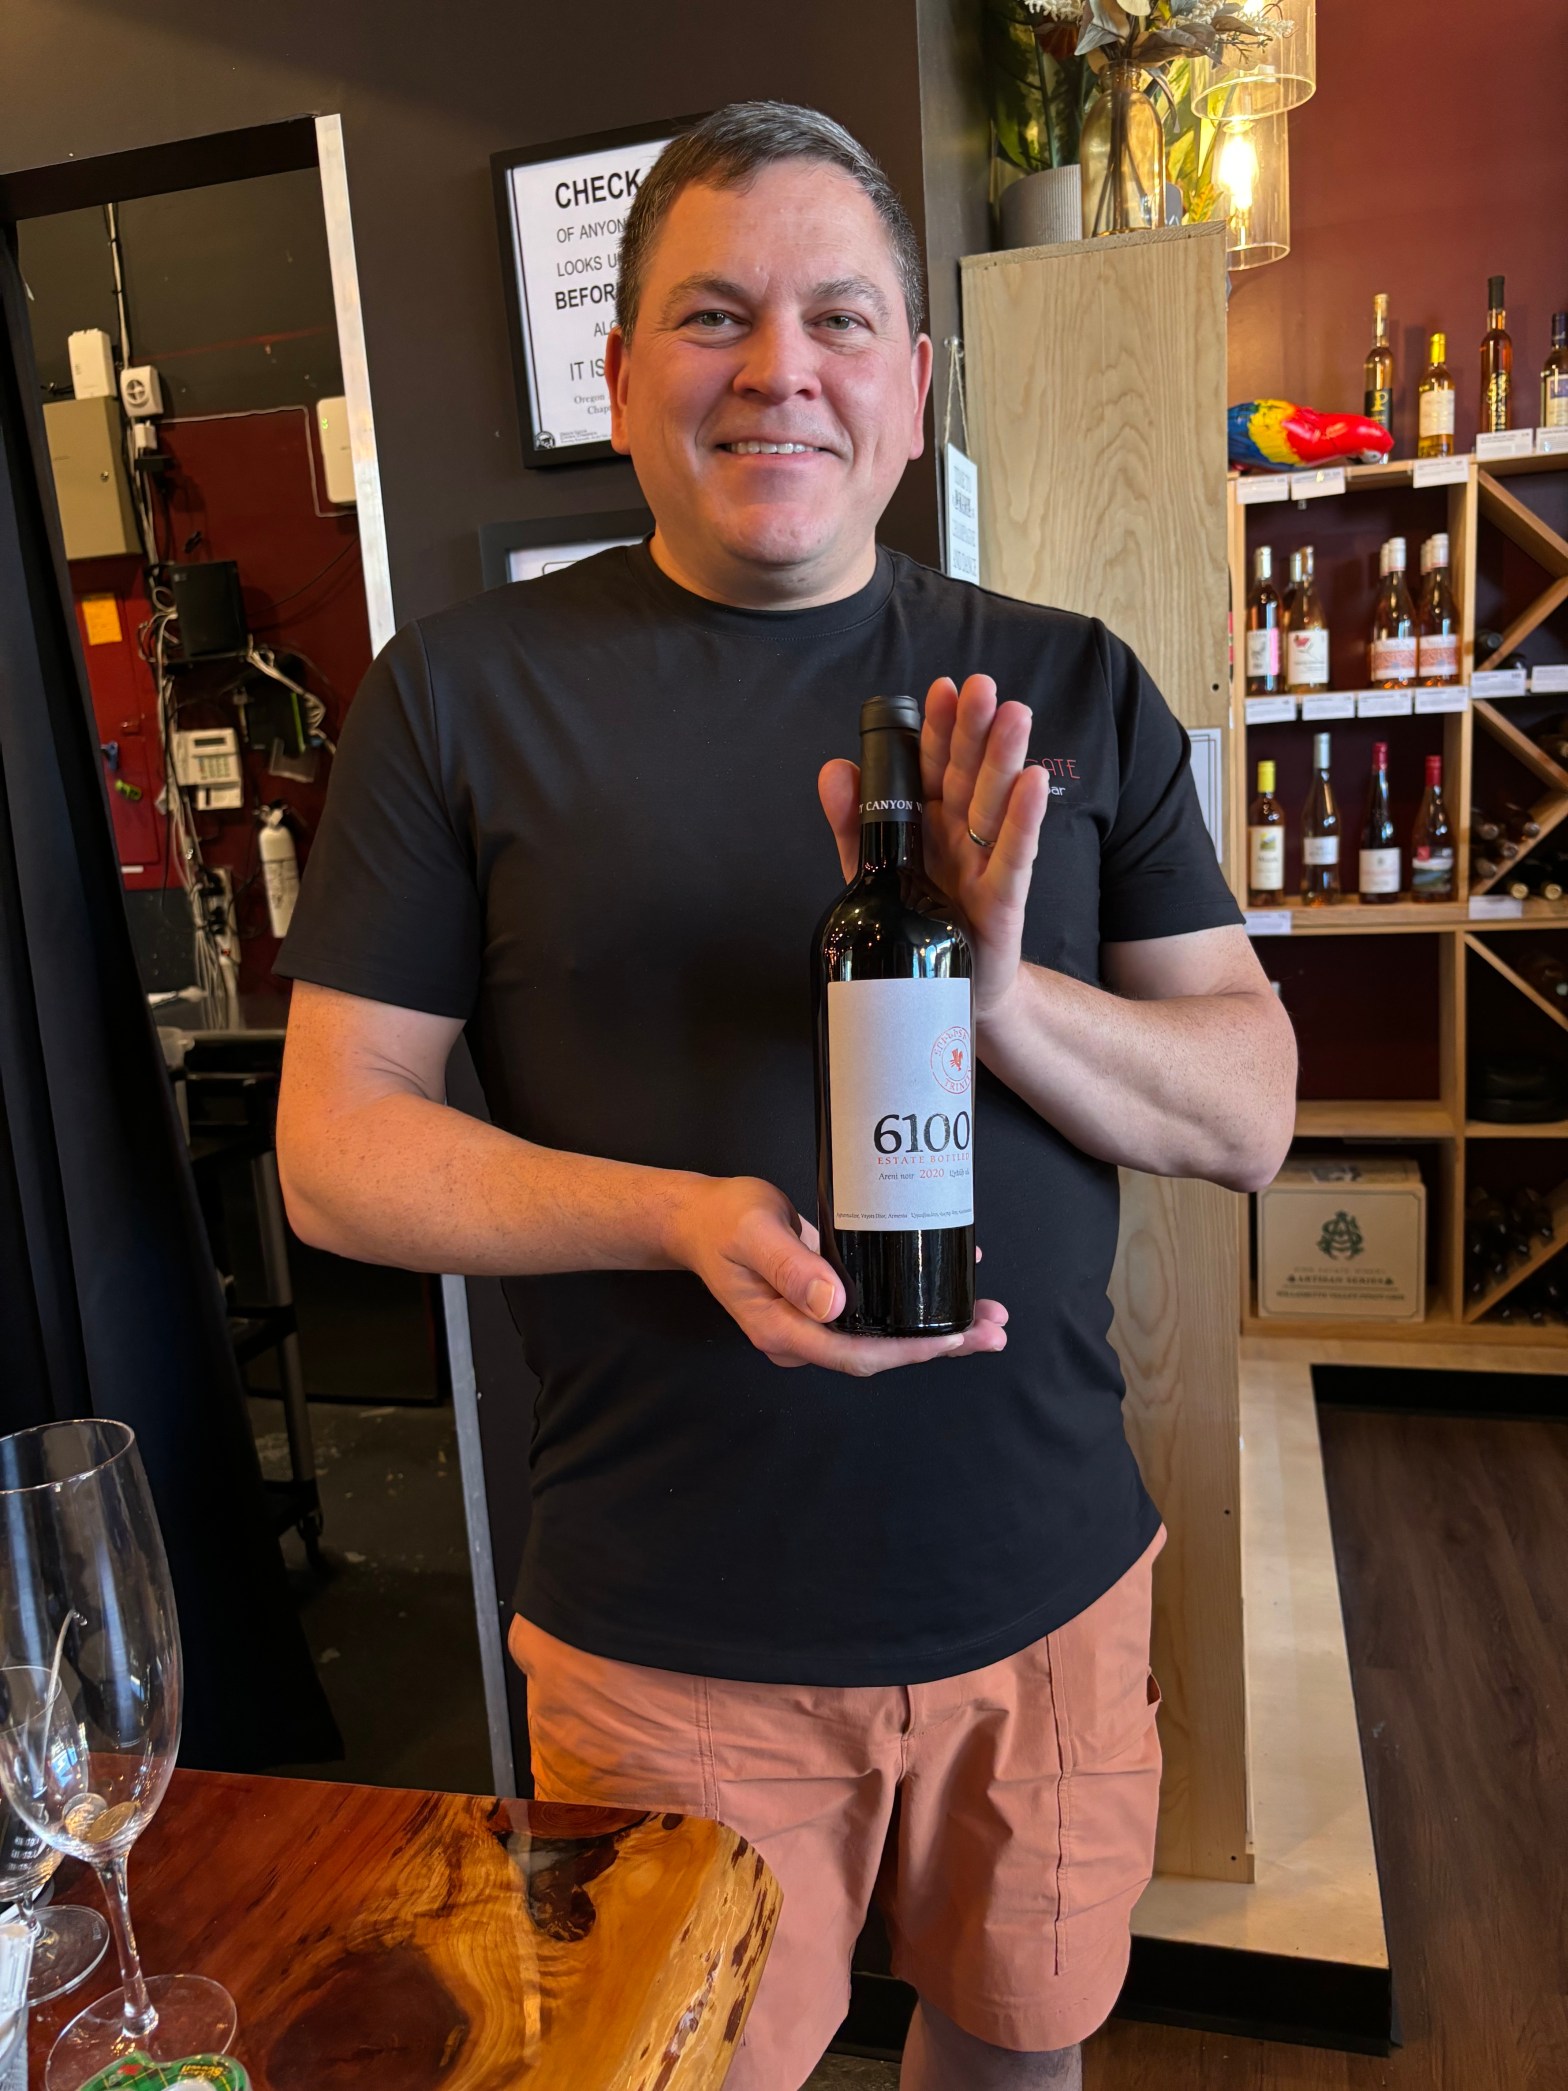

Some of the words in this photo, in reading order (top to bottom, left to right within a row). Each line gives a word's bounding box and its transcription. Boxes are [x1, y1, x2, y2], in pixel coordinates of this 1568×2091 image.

[555, 168, 641, 209] CHECK
[556, 226, 574, 243] OF
[556, 255, 603, 277] LOOKS
[570, 361, 584, 381] IT
[574, 394, 605, 404] Oregon
[587, 405, 611, 415] Chap
[1025, 758, 1081, 779] ATE
[866, 799, 913, 811] CANYON
[874, 1110, 970, 1155] 6100
[877, 1156, 925, 1165] ESTATE
[930, 1152, 970, 1163] BOTTLED
[879, 1172, 898, 1180] Areni
[920, 1168, 945, 1179] 2020
